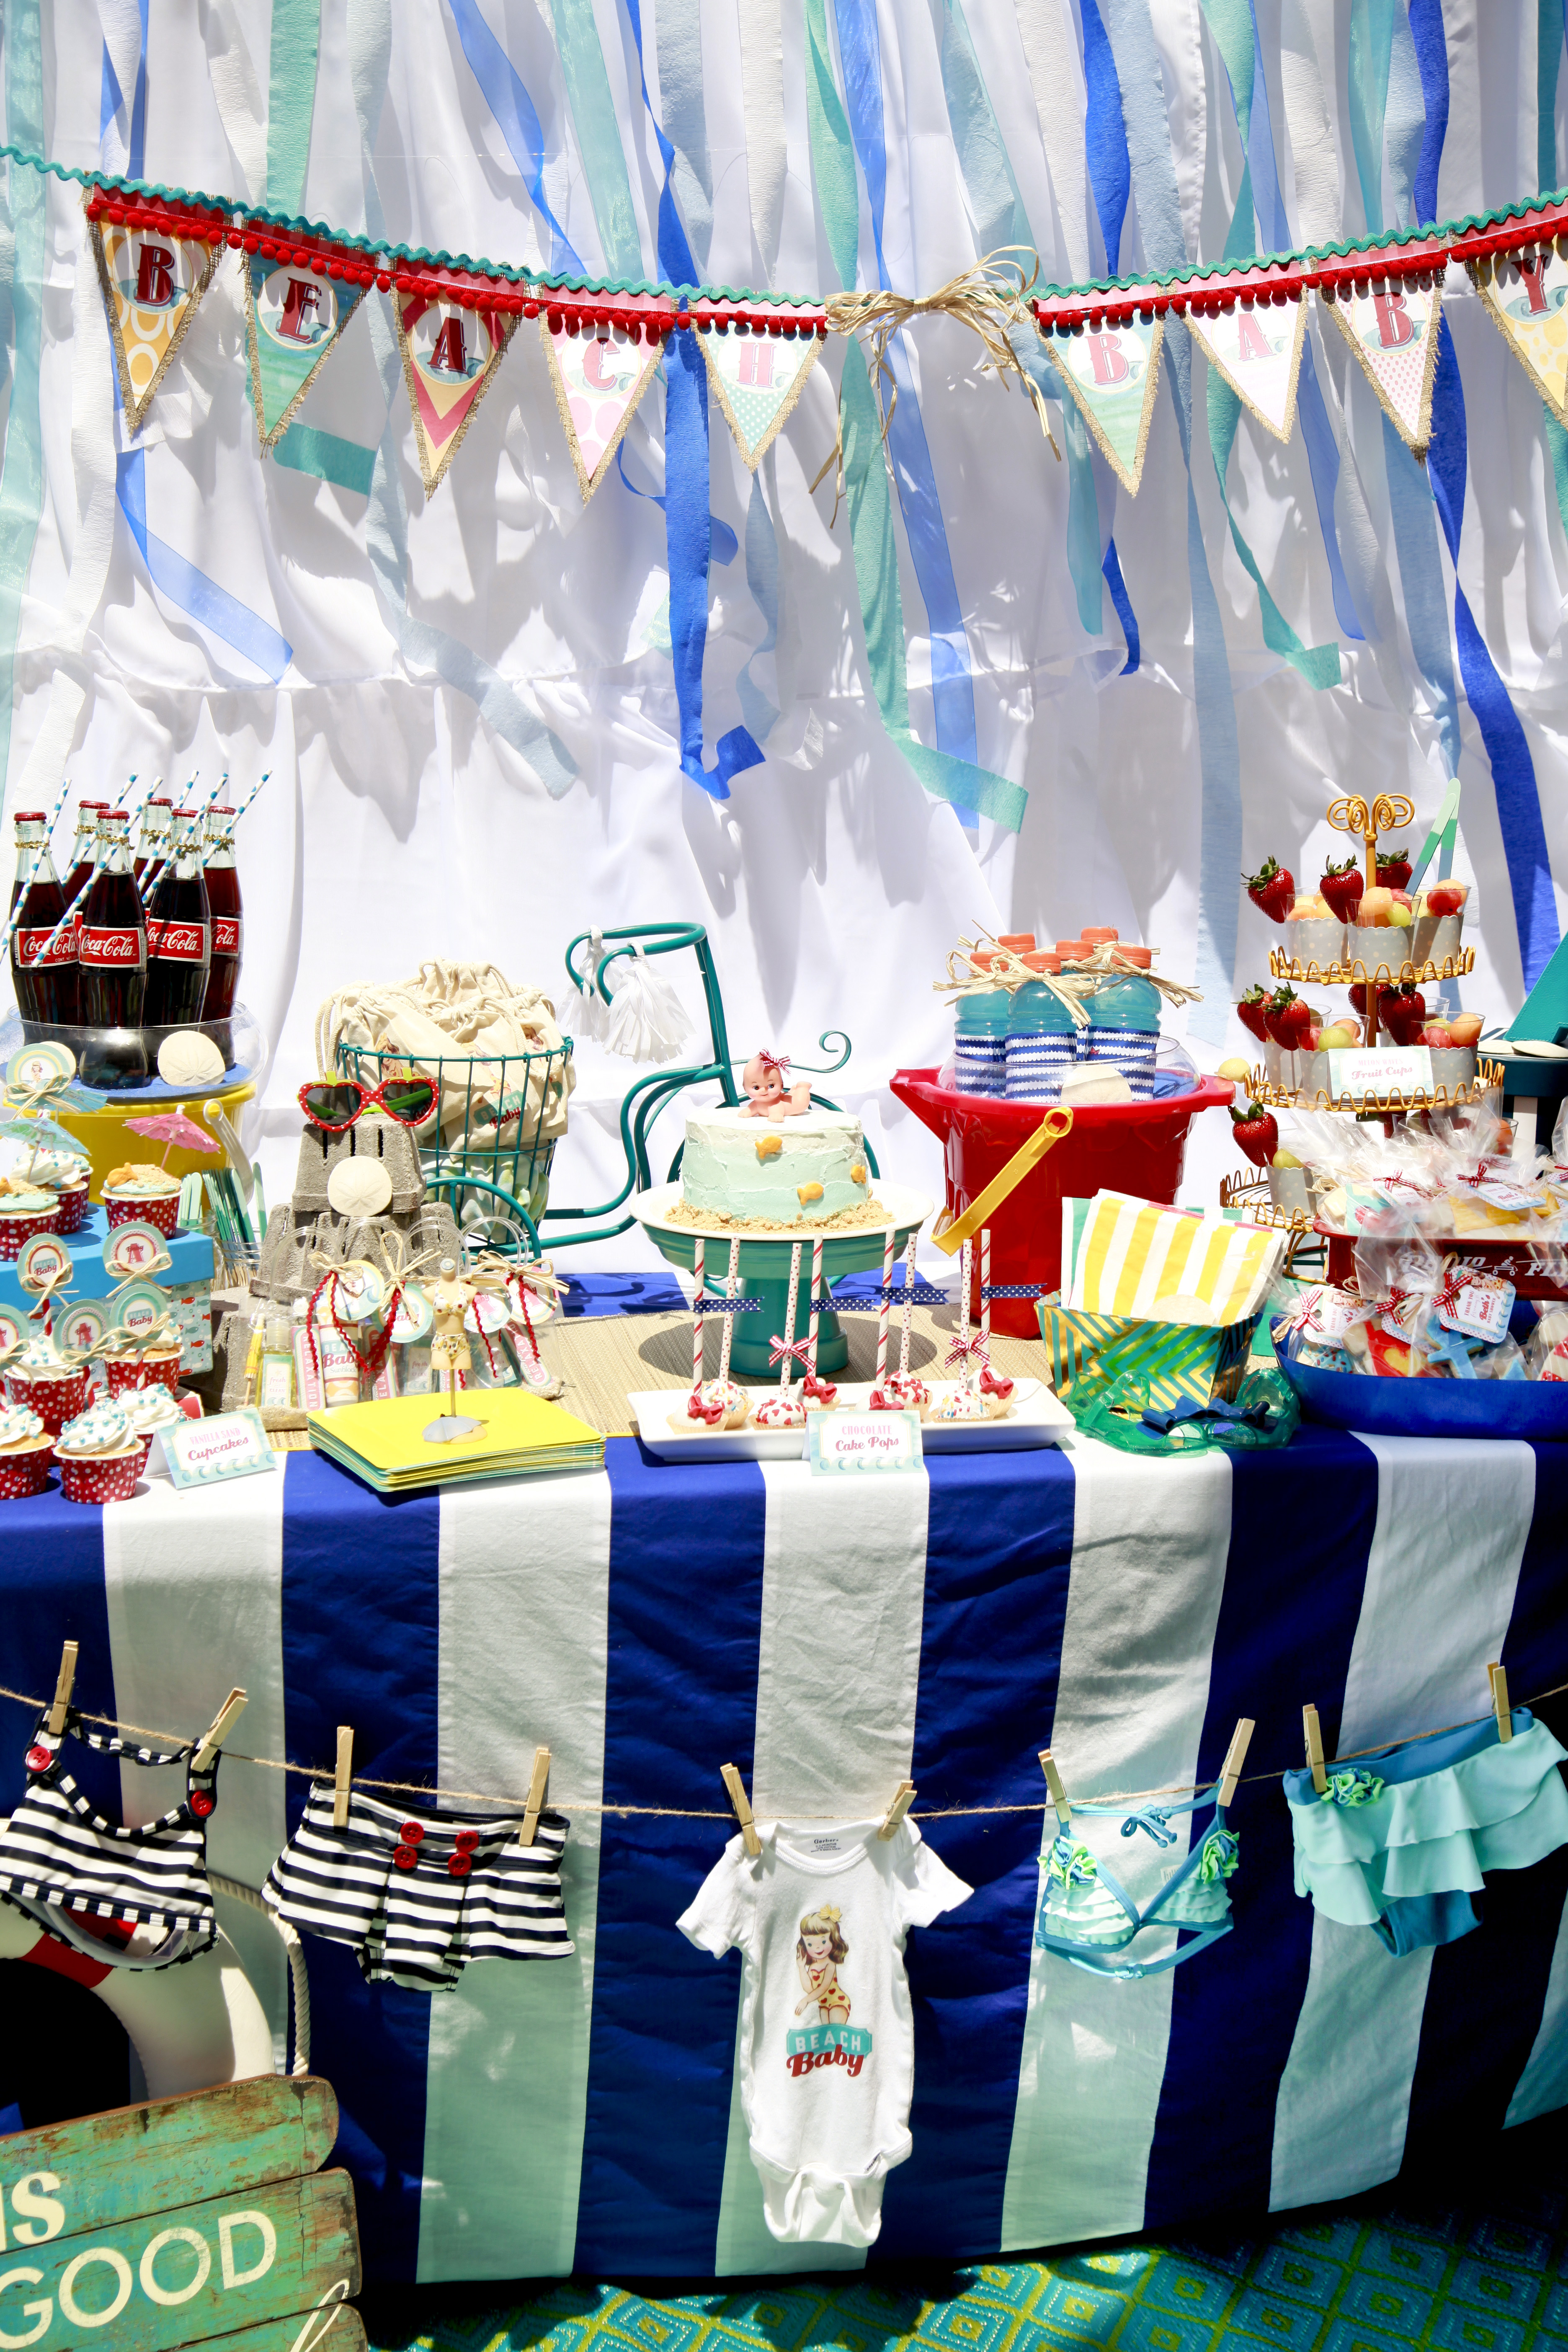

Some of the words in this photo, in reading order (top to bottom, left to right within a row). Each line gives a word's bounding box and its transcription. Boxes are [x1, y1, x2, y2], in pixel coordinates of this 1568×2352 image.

[23, 932, 76, 957] CocCola
[81, 934, 134, 957] Coca-Cola
[148, 926, 199, 951] Coca-Cola
[1351, 1070, 1382, 1080] Fruit
[1385, 1067, 1413, 1076] Cups
[34, 1264, 57, 1276] Baby
[127, 1315, 152, 1328] Baby
[268, 1377, 286, 1385] fresh
[189, 1432, 220, 1445] VANILLA
[221, 1427, 241, 1439] SAND
[841, 1425, 892, 1435] CHOCOLATE
[188, 1436, 249, 1461] Cupcakes
[835, 1439, 865, 1452] Cake
[867, 1436, 899, 1451] Pops
[796, 2031, 861, 2053] BEACH
[786, 2044, 865, 2078] Baby
[0, 2210, 277, 2349] GOOD
